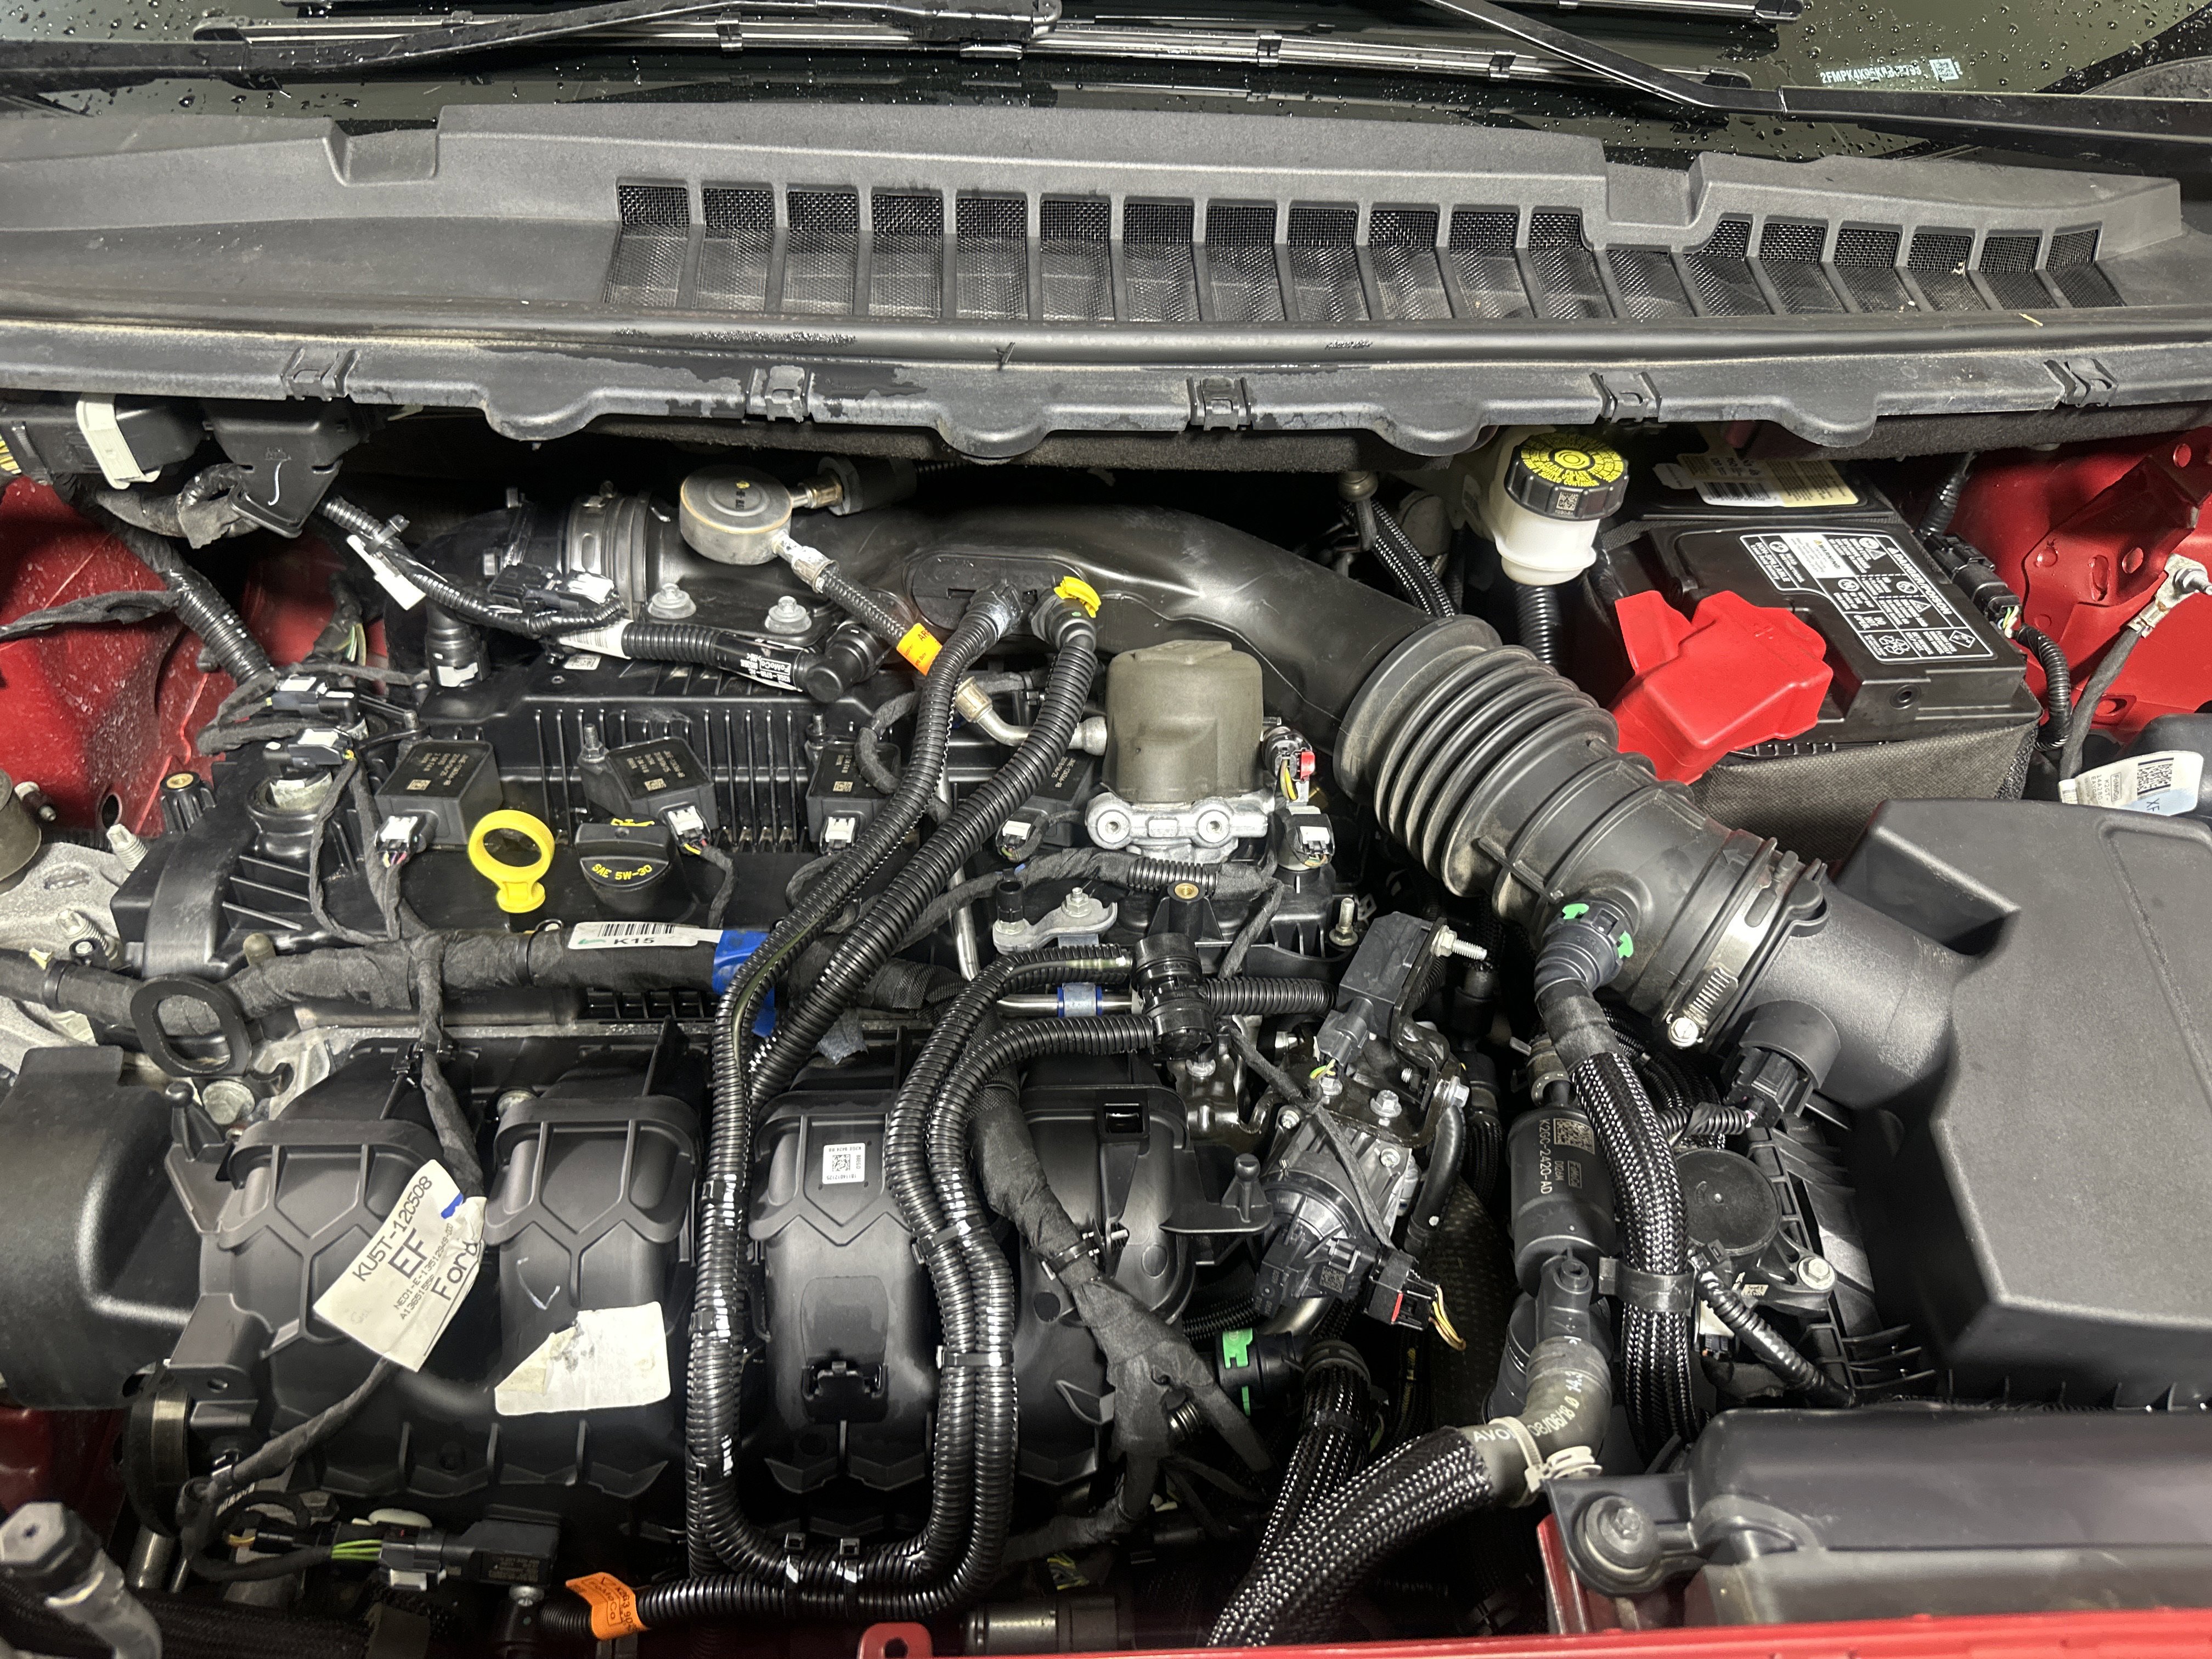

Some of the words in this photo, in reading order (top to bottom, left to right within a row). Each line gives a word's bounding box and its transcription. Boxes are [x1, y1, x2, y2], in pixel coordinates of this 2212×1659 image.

[1756, 542, 1791, 582] NON-SPILLABLE
[1891, 554, 1954, 614] DANGER/POISON
[2147, 798, 2160, 811] XF
[592, 864, 612, 878] SAE
[615, 865, 653, 880] 5W-30
[1539, 1119, 1553, 1194] K2GC-2420-AD
[352, 1176, 432, 1282] KU5T-12C508
[388, 1227, 427, 1279] EF
[431, 1240, 478, 1301] Ford
[1527, 1404, 1575, 1436] 08/06/18
